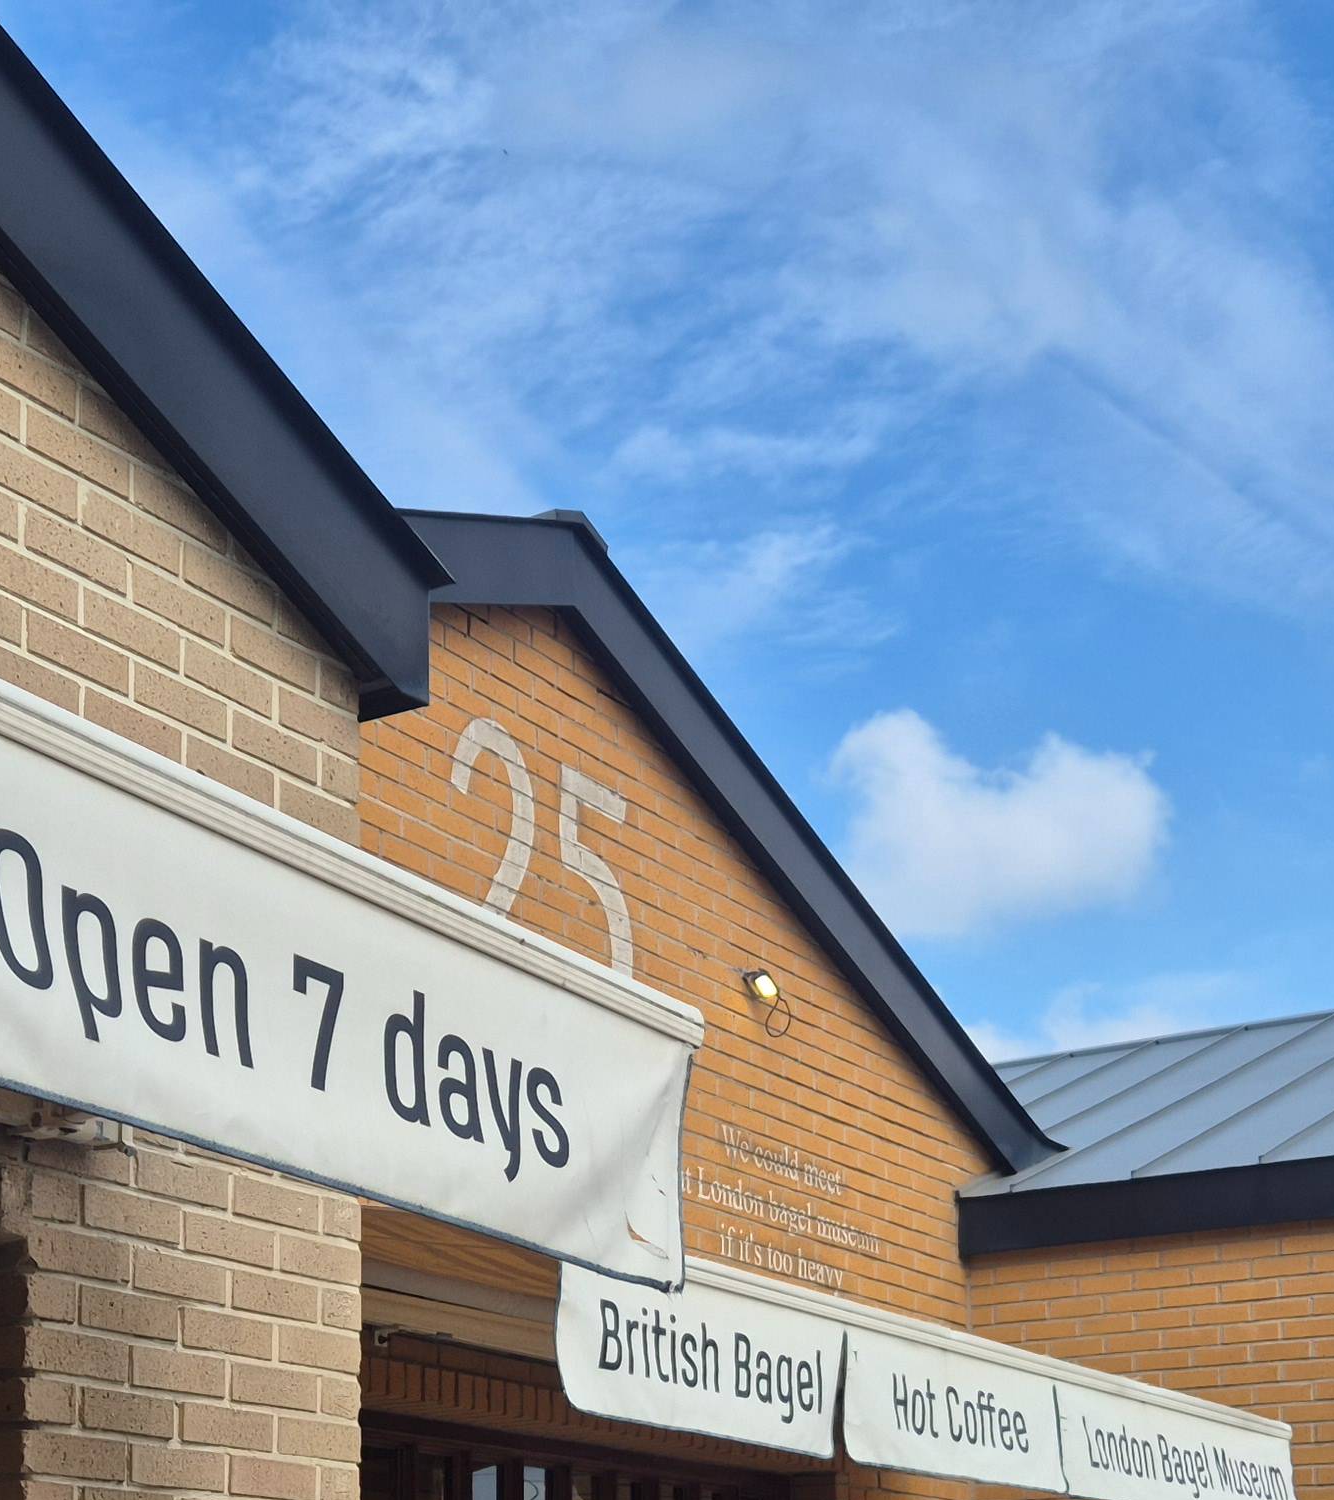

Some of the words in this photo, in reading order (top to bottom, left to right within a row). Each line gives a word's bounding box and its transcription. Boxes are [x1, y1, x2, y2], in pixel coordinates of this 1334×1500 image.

[451, 717, 634, 978] 25
[292, 952, 346, 1093] 7
[382, 988, 571, 1184] days
[721, 1123, 749, 1164] We
[754, 1144, 799, 1181] could
[803, 1162, 843, 1196] meet
[698, 1166, 765, 1218] London
[769, 1190, 812, 1237] bagel
[817, 1216, 880, 1255] museum
[720, 1223, 735, 1257] if
[738, 1228, 762, 1266] it's
[768, 1243, 793, 1274] too
[798, 1248, 844, 1292] heavy
[598, 1298, 720, 1394] British
[733, 1331, 824, 1425] Bagel
[891, 1372, 942, 1440] Hot
[946, 1384, 1030, 1454] Coffee
[1082, 1415, 1156, 1482] London
[1161, 1434, 1214, 1500] Bagel
